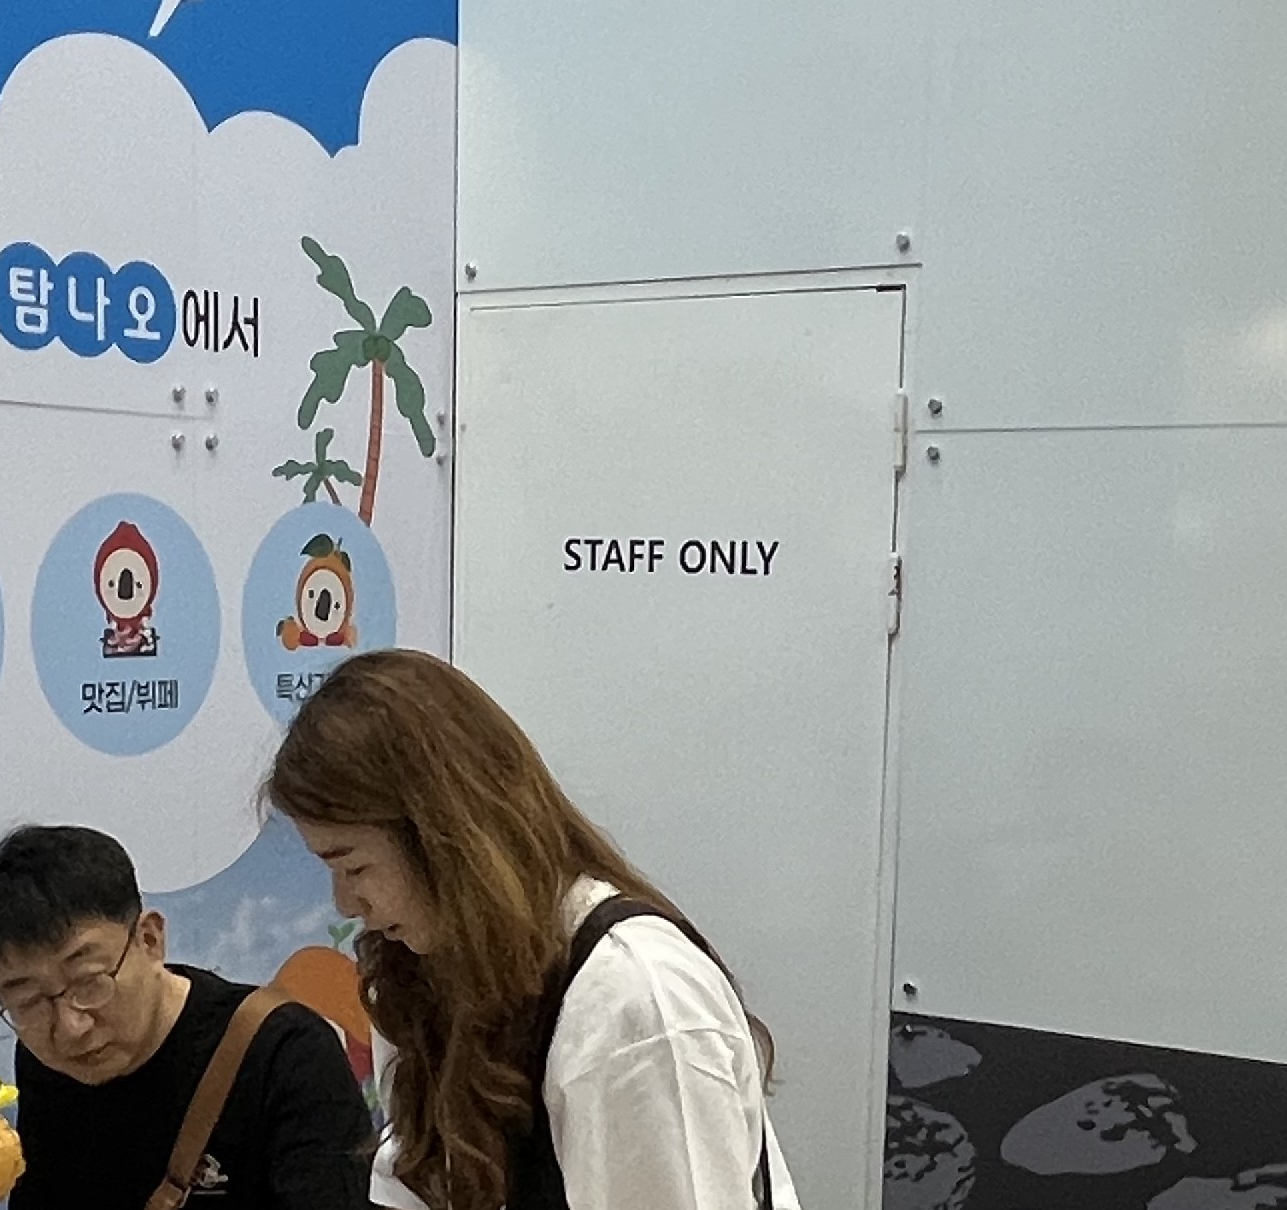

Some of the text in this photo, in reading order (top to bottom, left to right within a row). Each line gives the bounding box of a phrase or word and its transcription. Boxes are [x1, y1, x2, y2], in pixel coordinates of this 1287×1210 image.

[563, 538, 780, 576] STAFF ONLY
[81, 680, 179, 715] 맛집/뷔페
